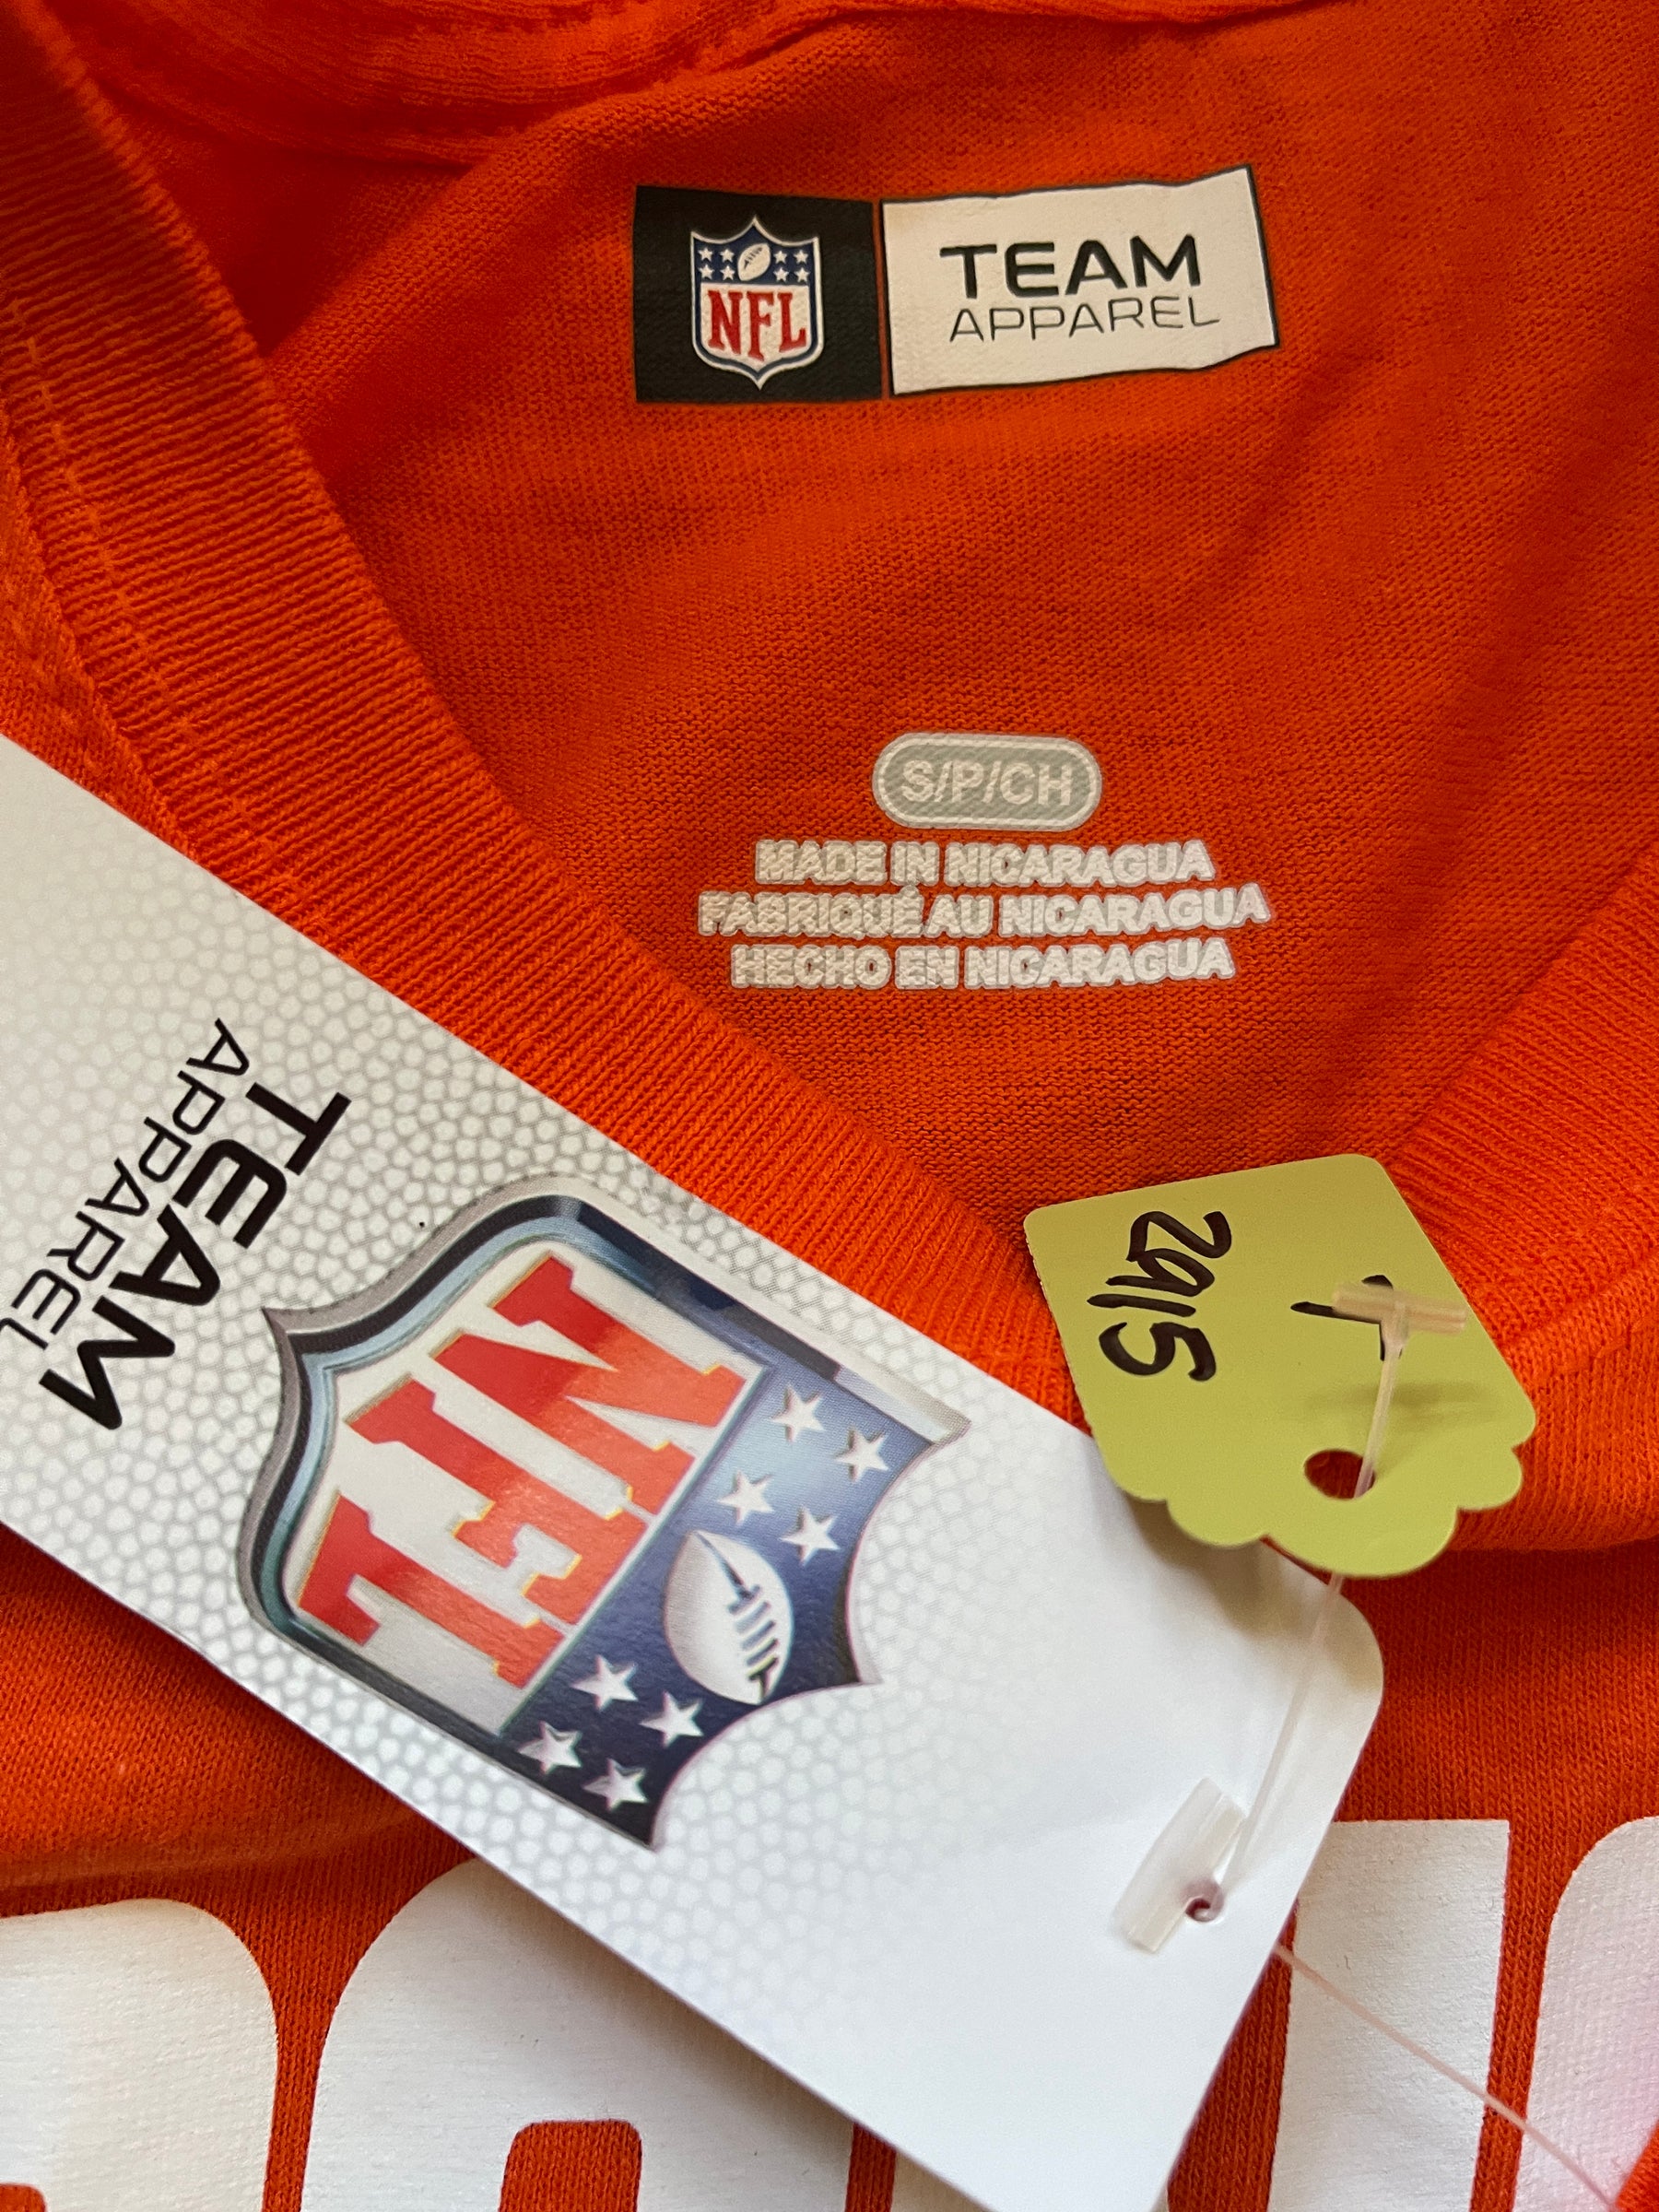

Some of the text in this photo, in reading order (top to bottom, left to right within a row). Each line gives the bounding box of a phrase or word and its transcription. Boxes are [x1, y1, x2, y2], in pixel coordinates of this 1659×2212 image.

[939, 234, 1201, 300] TEAM
[707, 288, 807, 362] NFL
[949, 295, 1221, 343] APPAREL
[901, 759, 1073, 807] S/P/CH
[756, 839, 1216, 887] MADE IN NICARAGUA
[699, 884, 1271, 938] FABRIQUÉ AU NICARAGUA
[731, 937, 1237, 989] HECHO EN NICARAGUA
[0, 1018, 250, 1350] APPAREL
[39, 1082, 352, 1430] TEAM
[1086, 1210, 1232, 1382] 2915
[297, 1253, 747, 1689] NFL
